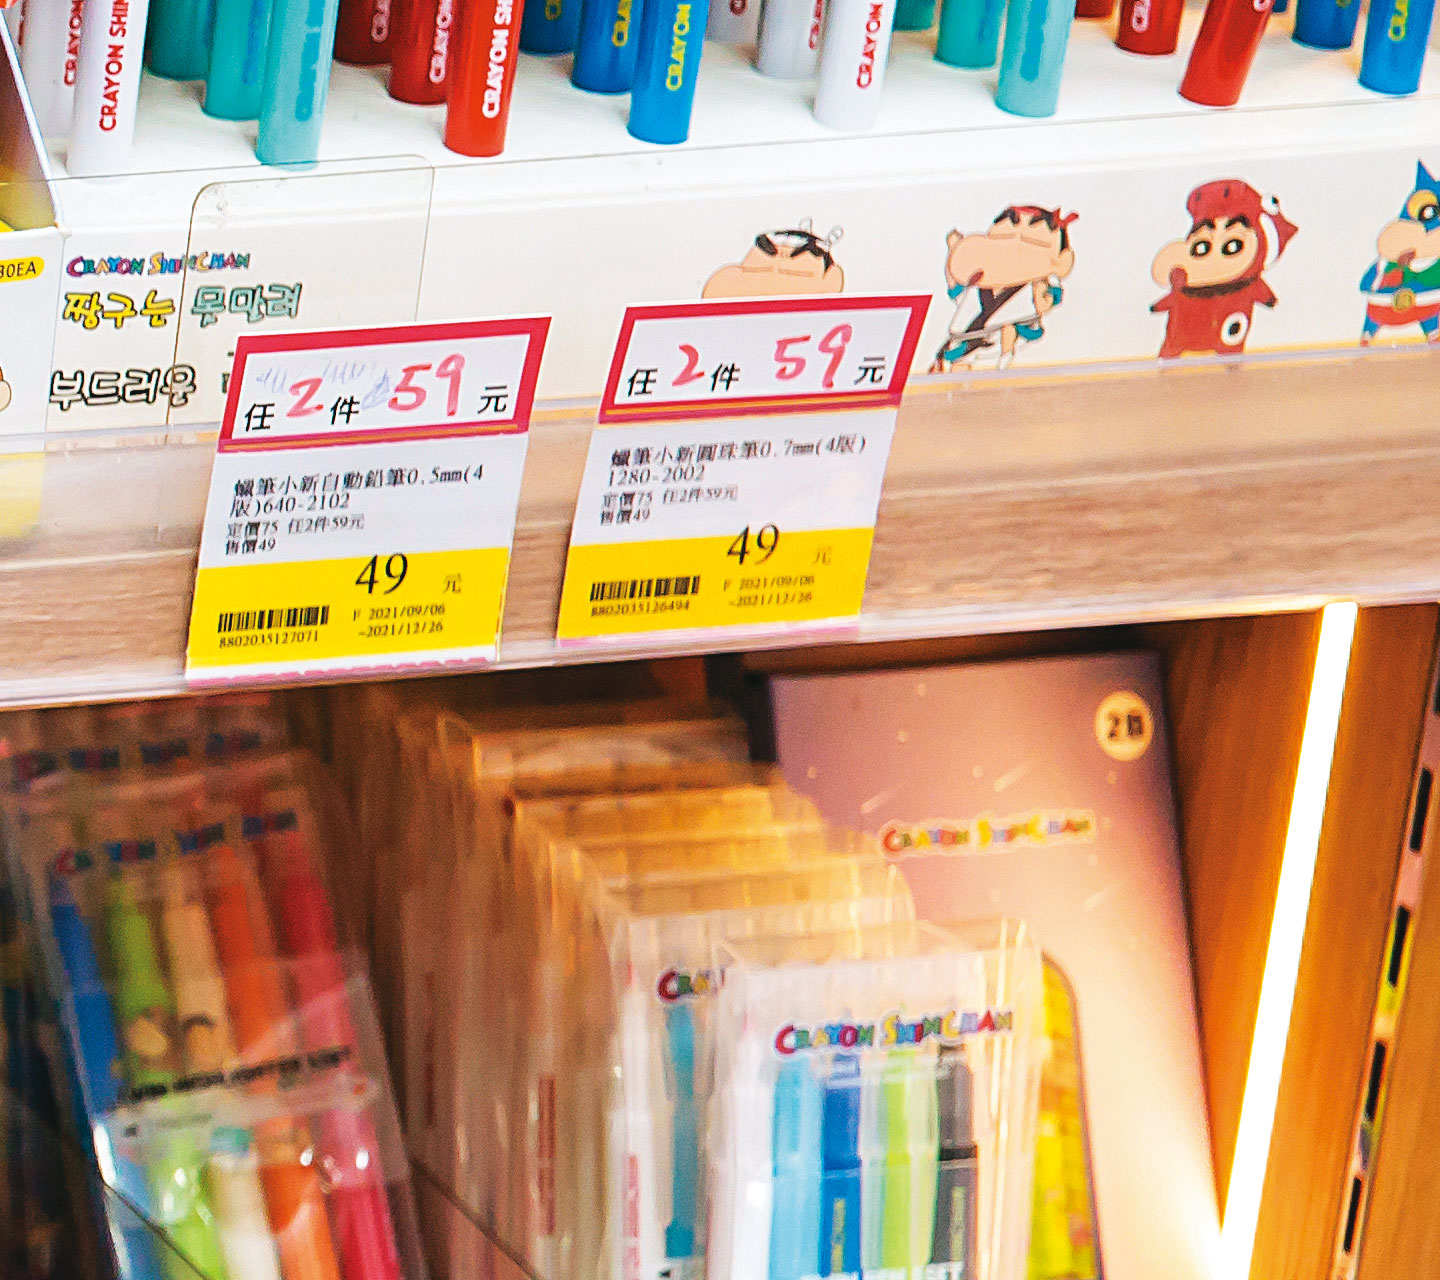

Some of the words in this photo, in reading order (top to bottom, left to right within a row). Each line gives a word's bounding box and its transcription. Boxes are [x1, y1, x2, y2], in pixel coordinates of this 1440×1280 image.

[99, 40, 124, 133] CRAYON
[482, 22, 510, 119] CRAYON
[244, 403, 275, 431] 任
[286, 378, 324, 417] 2
[331, 396, 360, 425] 件
[389, 353, 466, 417] 59
[479, 385, 509, 414] 元
[627, 368, 657, 396] 任
[672, 345, 706, 387] 2
[710, 363, 740, 390] 件
[775, 323, 853, 389] 59
[856, 356, 886, 384] 元
[356, 554, 408, 595] 49
[728, 524, 779, 566] 49
